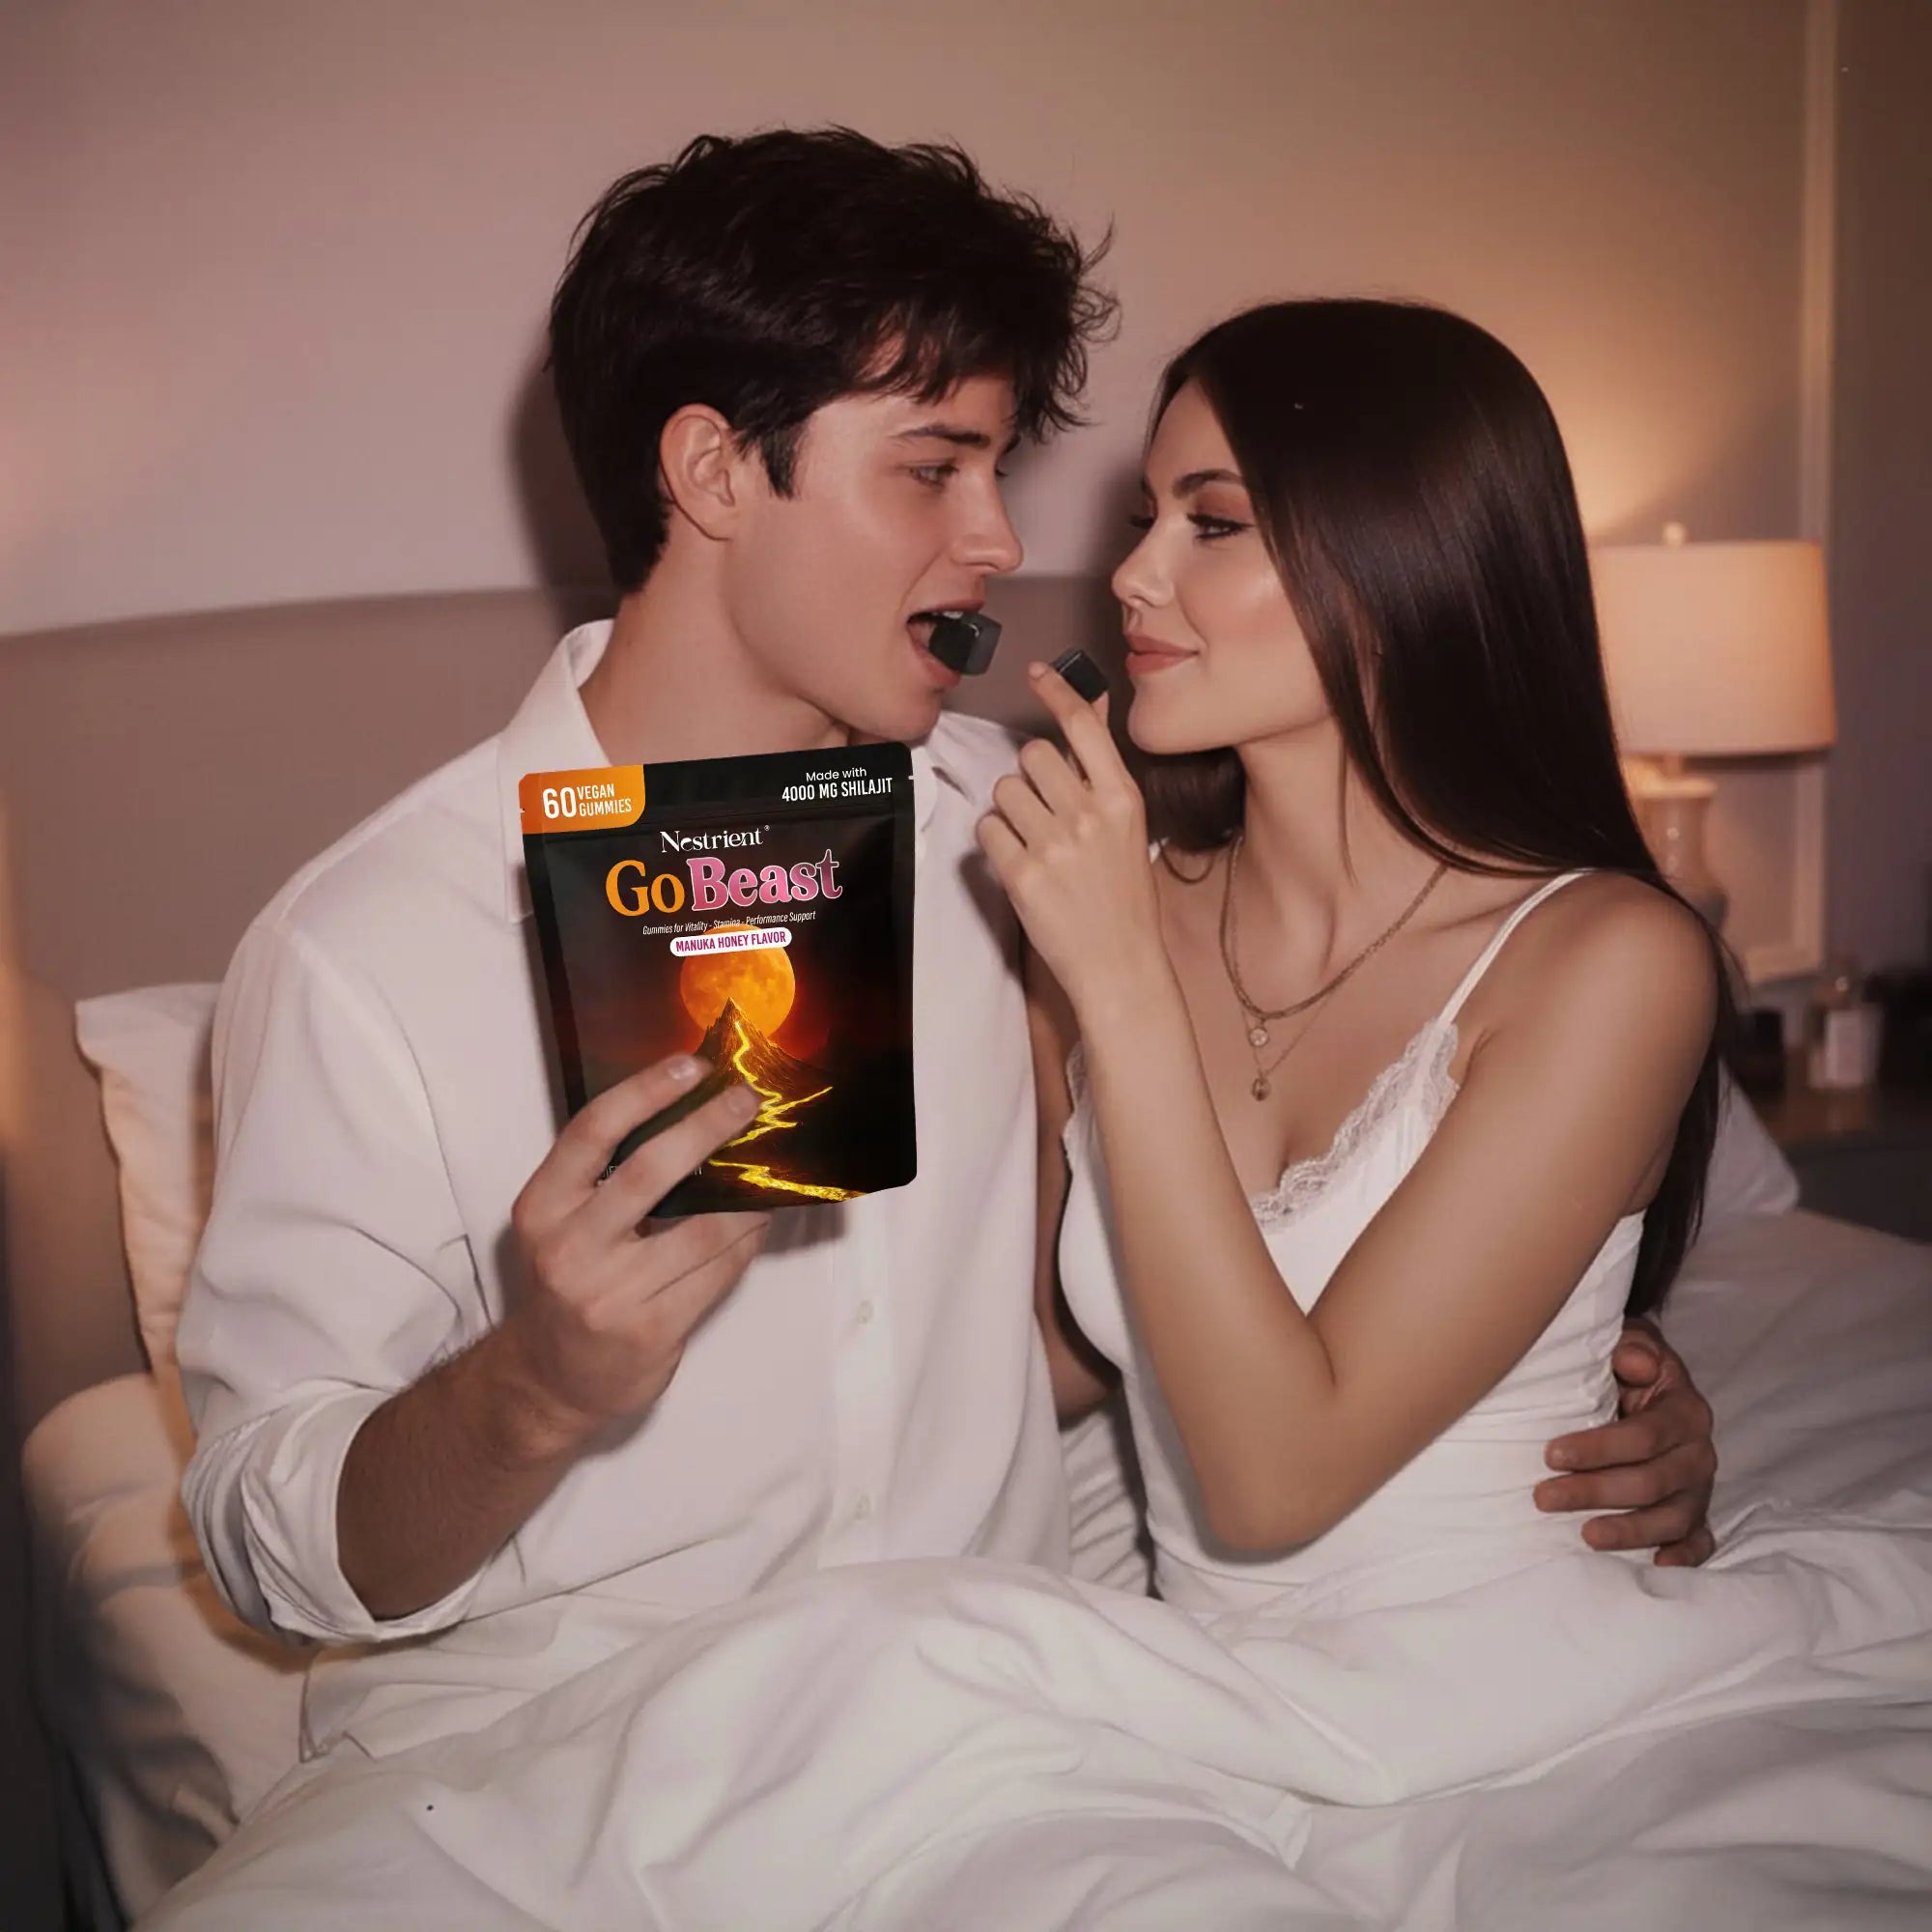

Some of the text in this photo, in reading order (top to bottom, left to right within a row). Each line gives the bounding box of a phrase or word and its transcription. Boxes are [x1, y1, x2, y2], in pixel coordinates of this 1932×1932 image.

[806, 767, 867, 781] Made with
[577, 783, 615, 800] VEGAN
[781, 778, 893, 802] 4000 MG SHILAJIT
[542, 786, 577, 819] 60
[579, 798, 633, 817] GUMMIES
[606, 849, 843, 917] Go Beast
[642, 923, 673, 935] Gummies
[674, 923, 684, 933] for
[685, 922, 708, 932] Vitality
[713, 917, 741, 929] Stamina
[746, 914, 788, 925] Performance
[789, 911, 816, 923] Support
[675, 930, 787, 952] MANUKA HONEY FLAVOR
